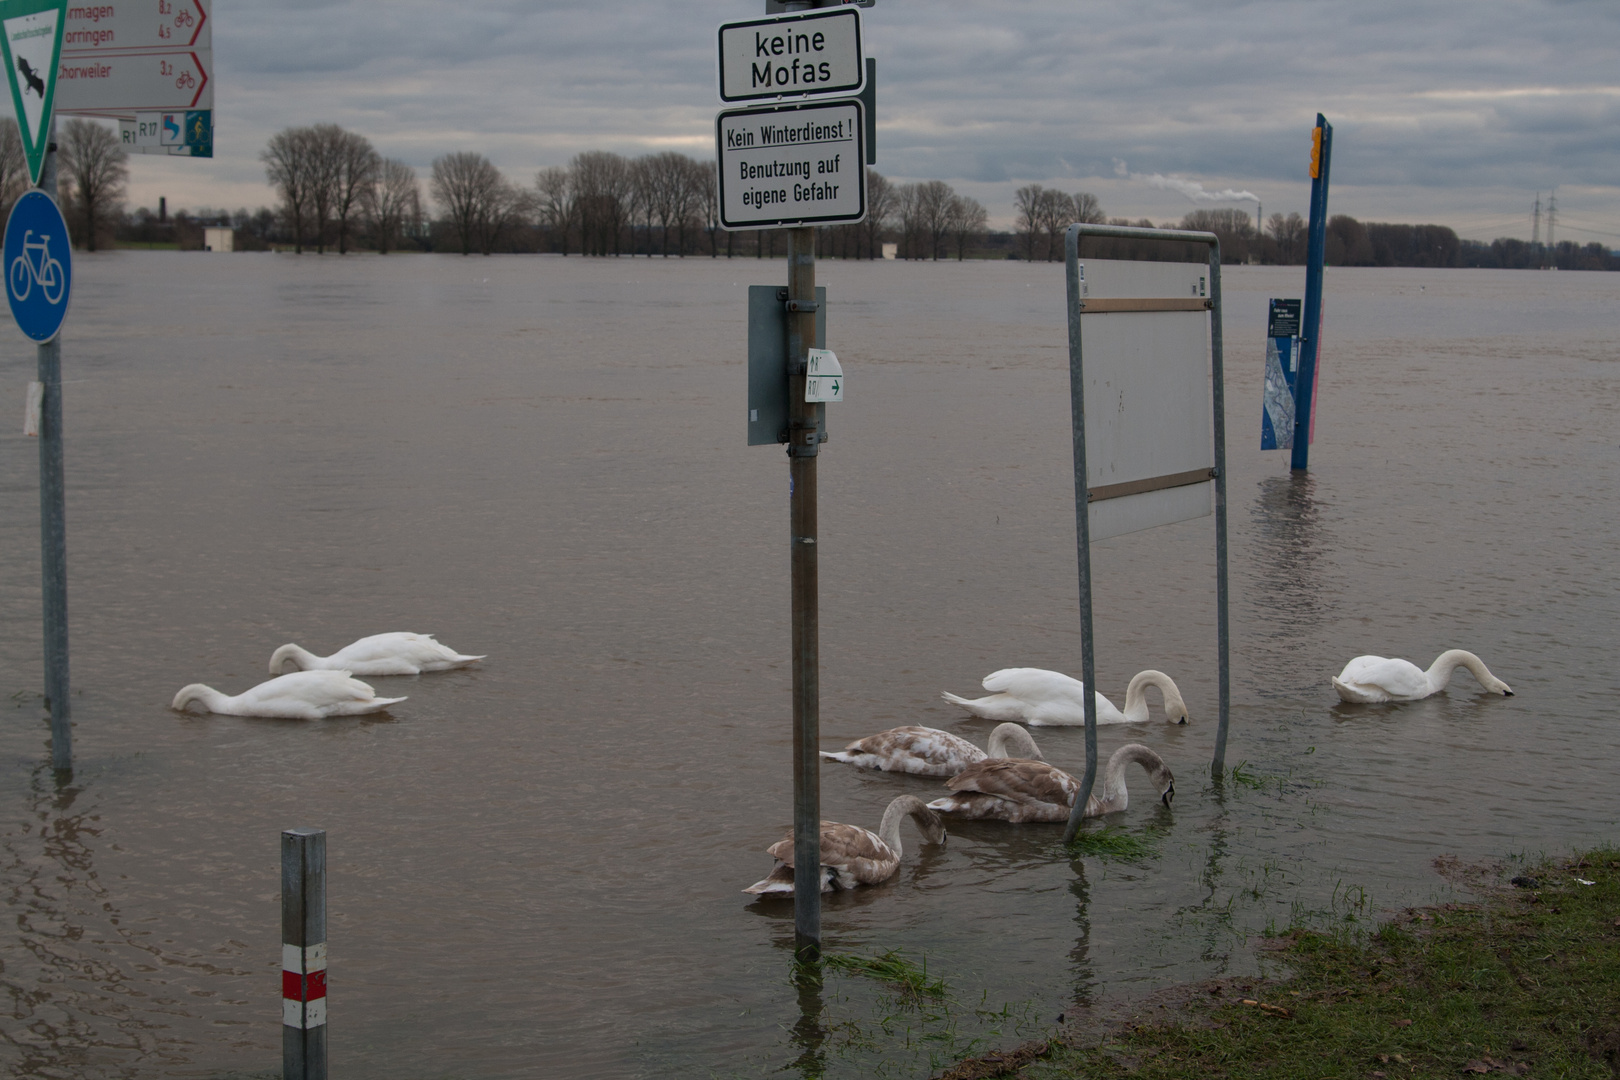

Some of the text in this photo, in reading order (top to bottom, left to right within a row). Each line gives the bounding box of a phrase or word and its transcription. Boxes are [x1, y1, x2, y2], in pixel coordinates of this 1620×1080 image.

[67, 6, 114, 22] rmagen
[66, 26, 114, 46] orringen
[756, 28, 825, 57] keine
[752, 58, 831, 88] Mofas
[122, 130, 130, 144] R
[139, 122, 157, 136] R 17
[727, 128, 754, 147] Kein
[761, 121, 843, 144] Winterdienst
[740, 154, 840, 180] Benutzung auf
[743, 181, 839, 209] eigene Gefahr
